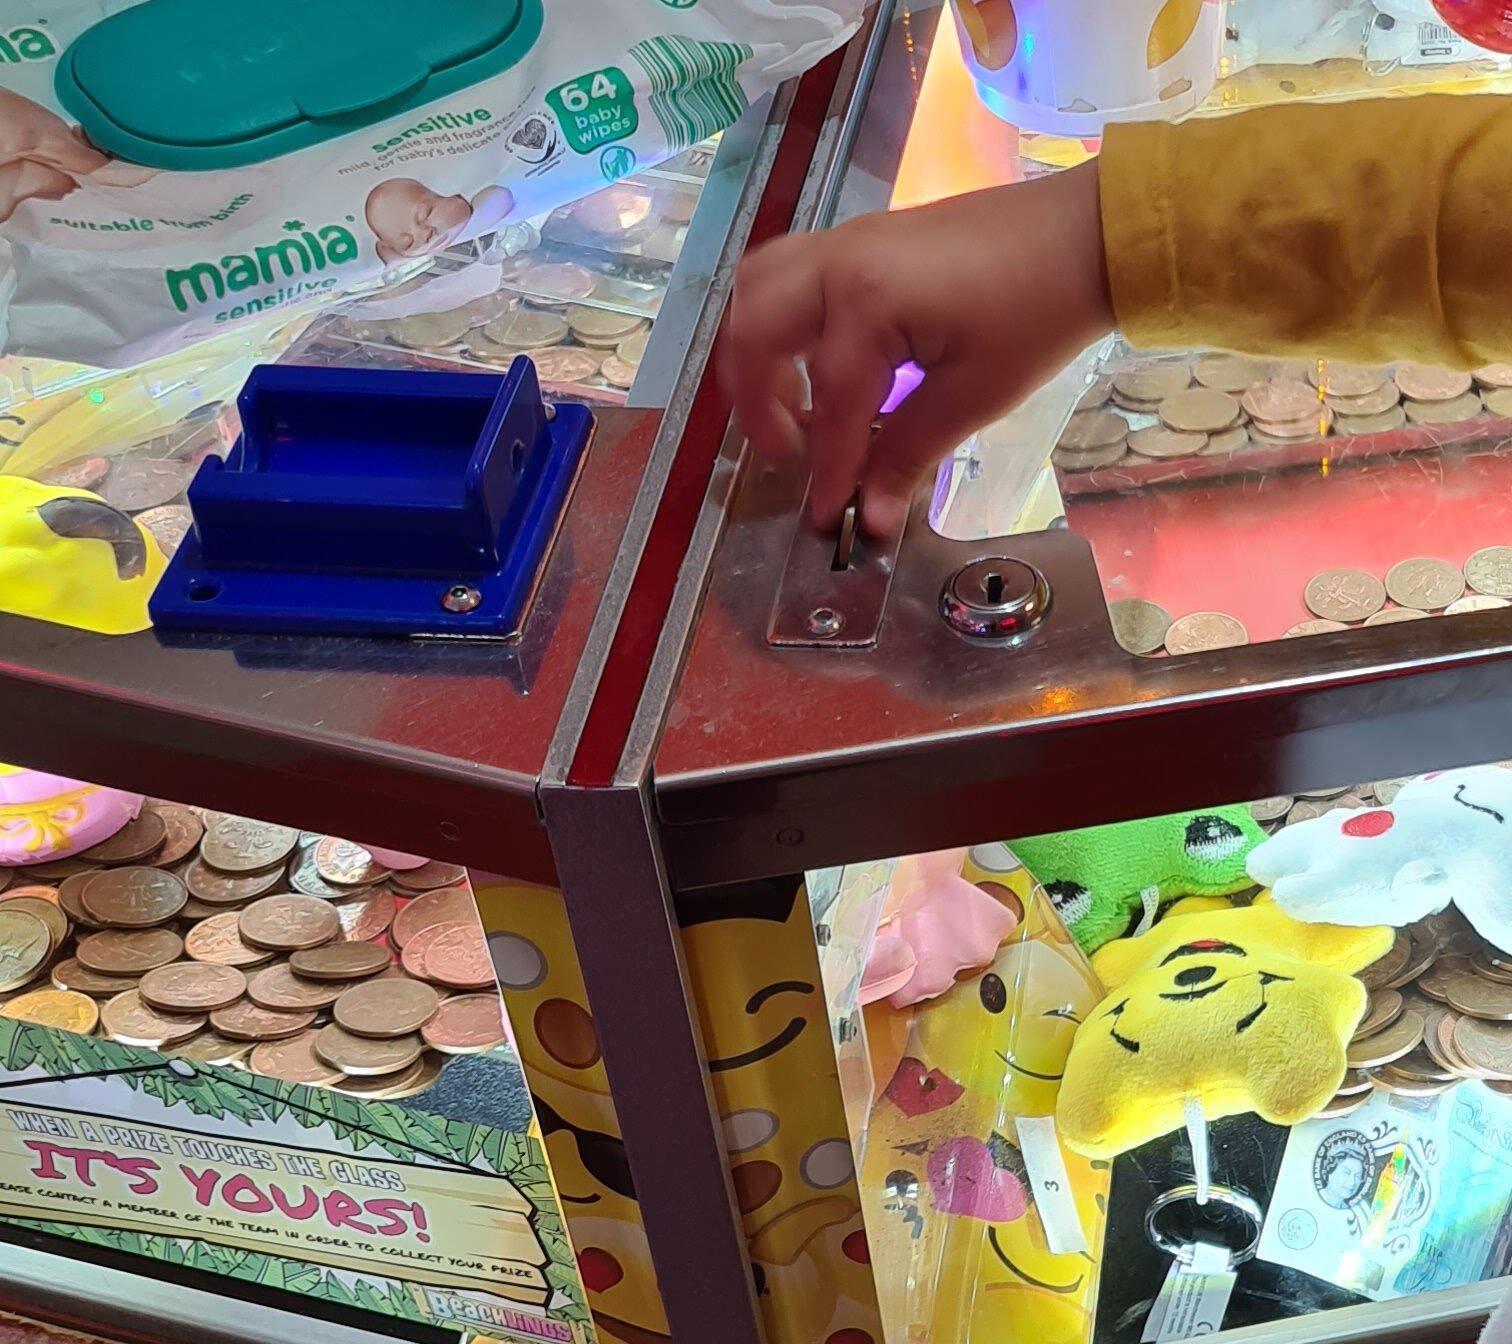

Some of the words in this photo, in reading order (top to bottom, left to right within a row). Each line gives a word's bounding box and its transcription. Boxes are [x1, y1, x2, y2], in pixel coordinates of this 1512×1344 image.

[560, 73, 617, 112] 64
[371, 108, 492, 153] sensitive
[575, 104, 622, 128] baby
[578, 117, 631, 144] wipes
[373, 159, 395, 172] for
[397, 146, 446, 164] baby's
[446, 131, 502, 156] delicate
[378, 139, 423, 162] gentle
[426, 133, 451, 145] and
[50, 215, 154, 233] suitable
[158, 216, 212, 231] from
[210, 192, 254, 222] birth
[165, 219, 359, 313] mamia
[213, 277, 339, 324] sensitive
[6, 1109, 79, 1140] WHEN
[82, 1119, 105, 1144] A
[104, 1123, 170, 1154] PRIZE
[172, 1134, 277, 1172] TOUCHES
[276, 1151, 326, 1181] THE
[328, 1159, 406, 1193] GLASS
[23, 1139, 162, 1196] IT'S
[178, 1162, 431, 1244] YOURS!
[1044, 1180, 1060, 1193] 3
[37, 1187, 99, 1206] CONTACT
[103, 1200, 113, 1209] A
[117, 1203, 180, 1221] MEMBER
[185, 1213, 202, 1223] OF
[208, 1216, 235, 1229] THE
[239, 1221, 280, 1237] TEAM
[285, 1229, 300, 1240] IN
[306, 1234, 353, 1250] ORDER
[355, 1242, 375, 1253] TO
[380, 1246, 445, 1265] COLLECT
[449, 1257, 488, 1272] YOUR
[491, 1264, 534, 1279] PRIZE
